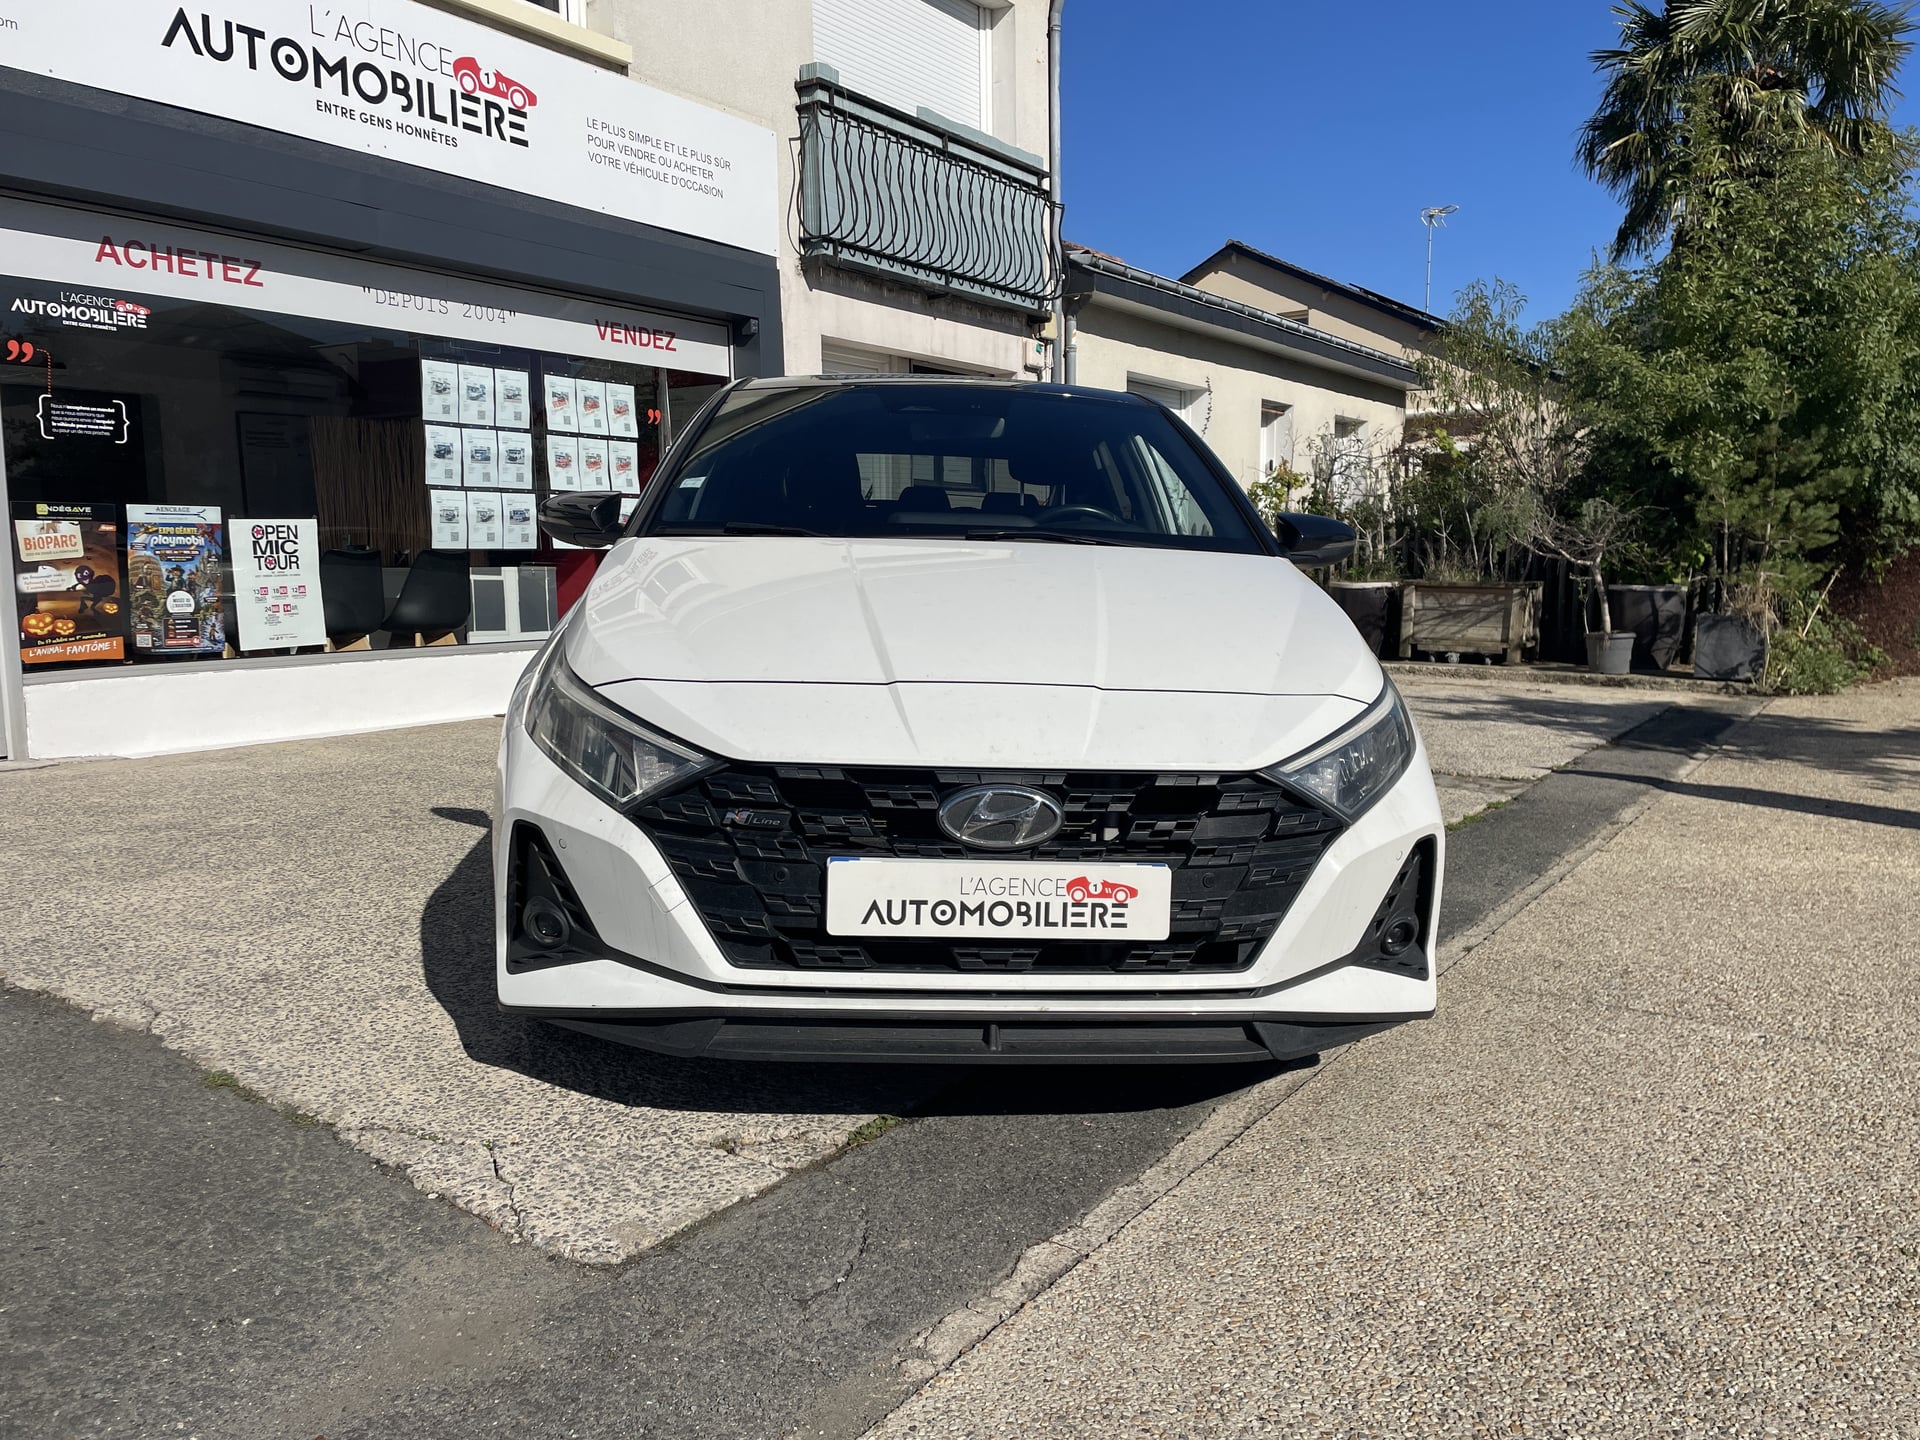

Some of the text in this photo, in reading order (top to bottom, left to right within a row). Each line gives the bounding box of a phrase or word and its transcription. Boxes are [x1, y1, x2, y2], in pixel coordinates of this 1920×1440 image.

[310, 4, 454, 78] L'AGENCE
[316, 99, 458, 148] ENTRE GENS HONNÊTES
[586, 117, 731, 171] LE PLUS SIMPLE ET LE PLUS SÛR
[587, 134, 714, 181] POUR VENDRE OU ACHETER
[588, 151, 724, 199] VOTRE VÉHICULE D'OCCASION
[95, 235, 264, 287] ACHETEZ
[60, 291, 116, 309] L'AGENCE
[594, 319, 677, 352] VENDEZ
[150, 535, 205, 548] playmobil
[251, 524, 298, 540] OPEN
[252, 539, 299, 555] MIC
[253, 555, 300, 571] TOUR
[29, 645, 65, 657] L'ANIMAL
[753, 817, 781, 826] Line
[960, 877, 1067, 897] L'AGENCE
